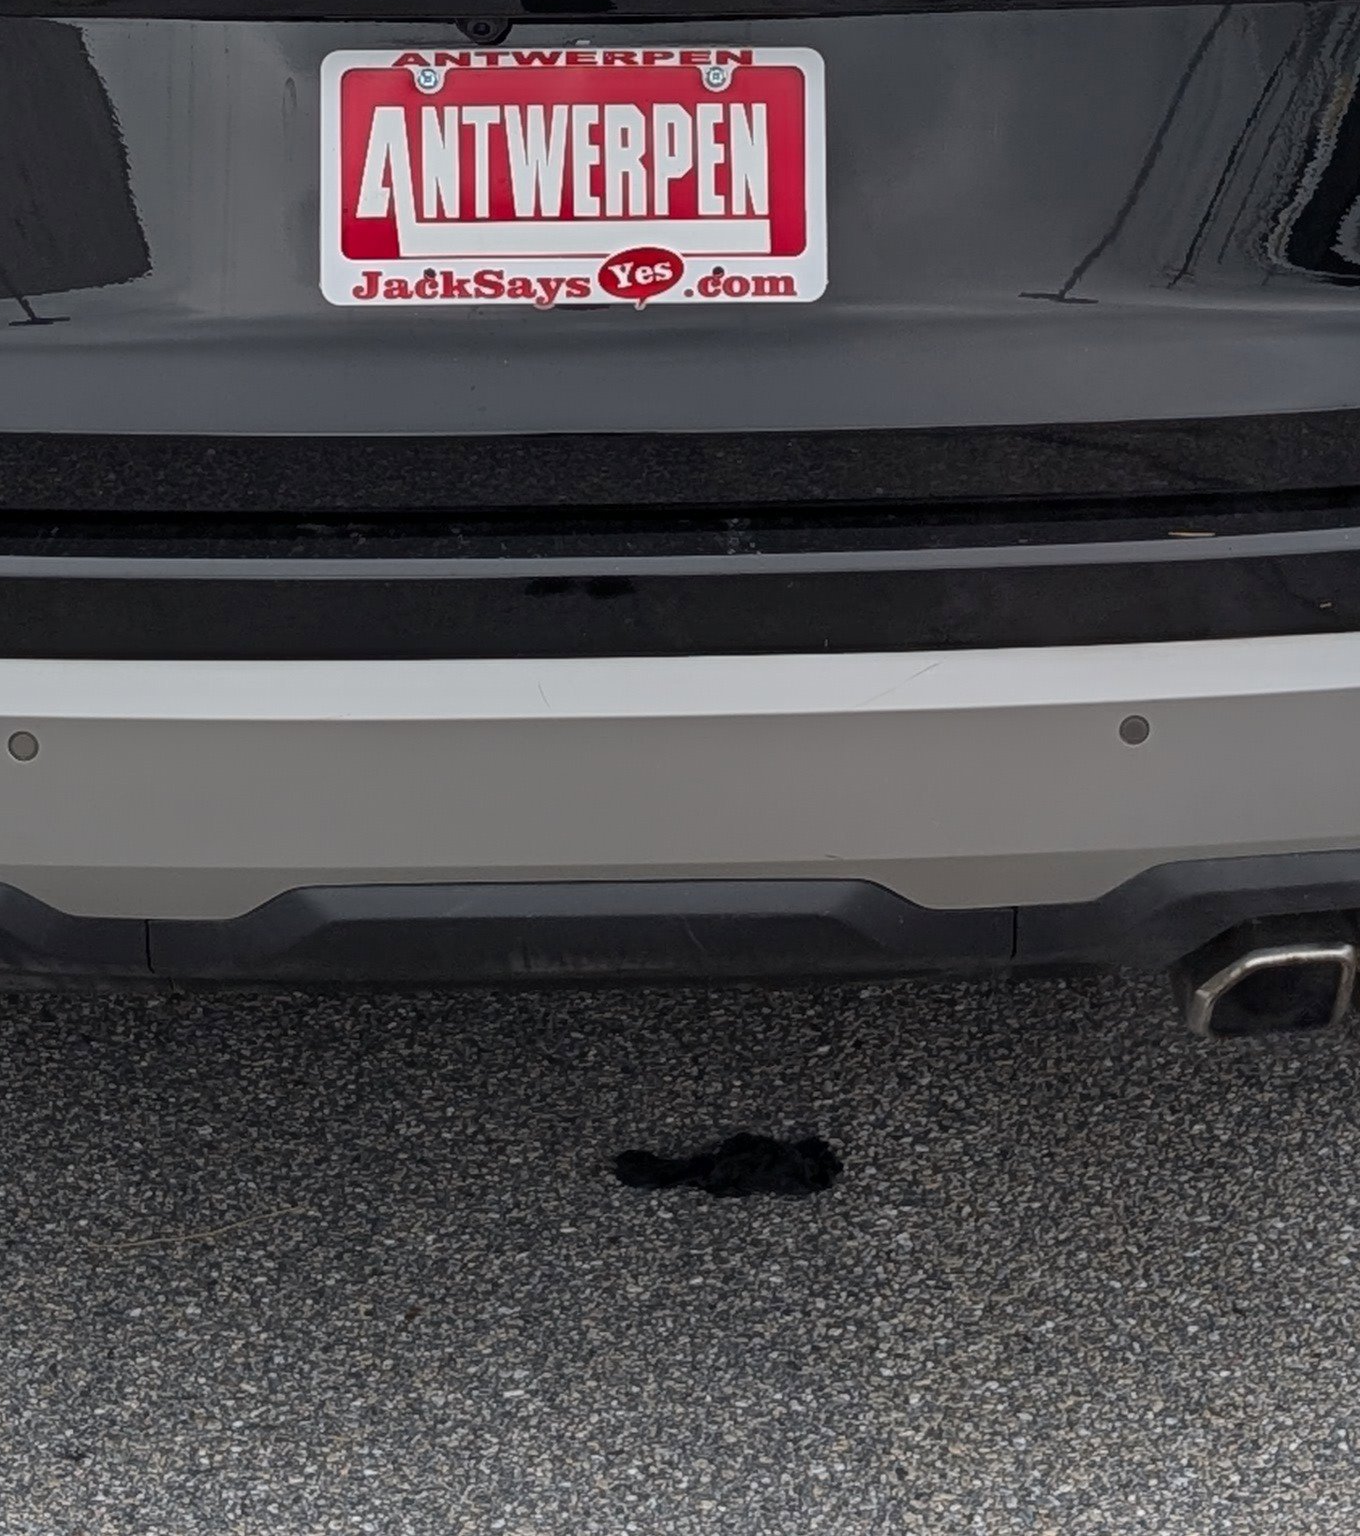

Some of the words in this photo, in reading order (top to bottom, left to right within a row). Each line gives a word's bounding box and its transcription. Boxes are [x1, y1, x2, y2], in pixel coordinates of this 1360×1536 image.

[392, 50, 754, 67] ANTWERPEN
[355, 102, 771, 224] ANTWERPEN
[351, 269, 592, 308] JackSays
[605, 260, 675, 290] Yes
